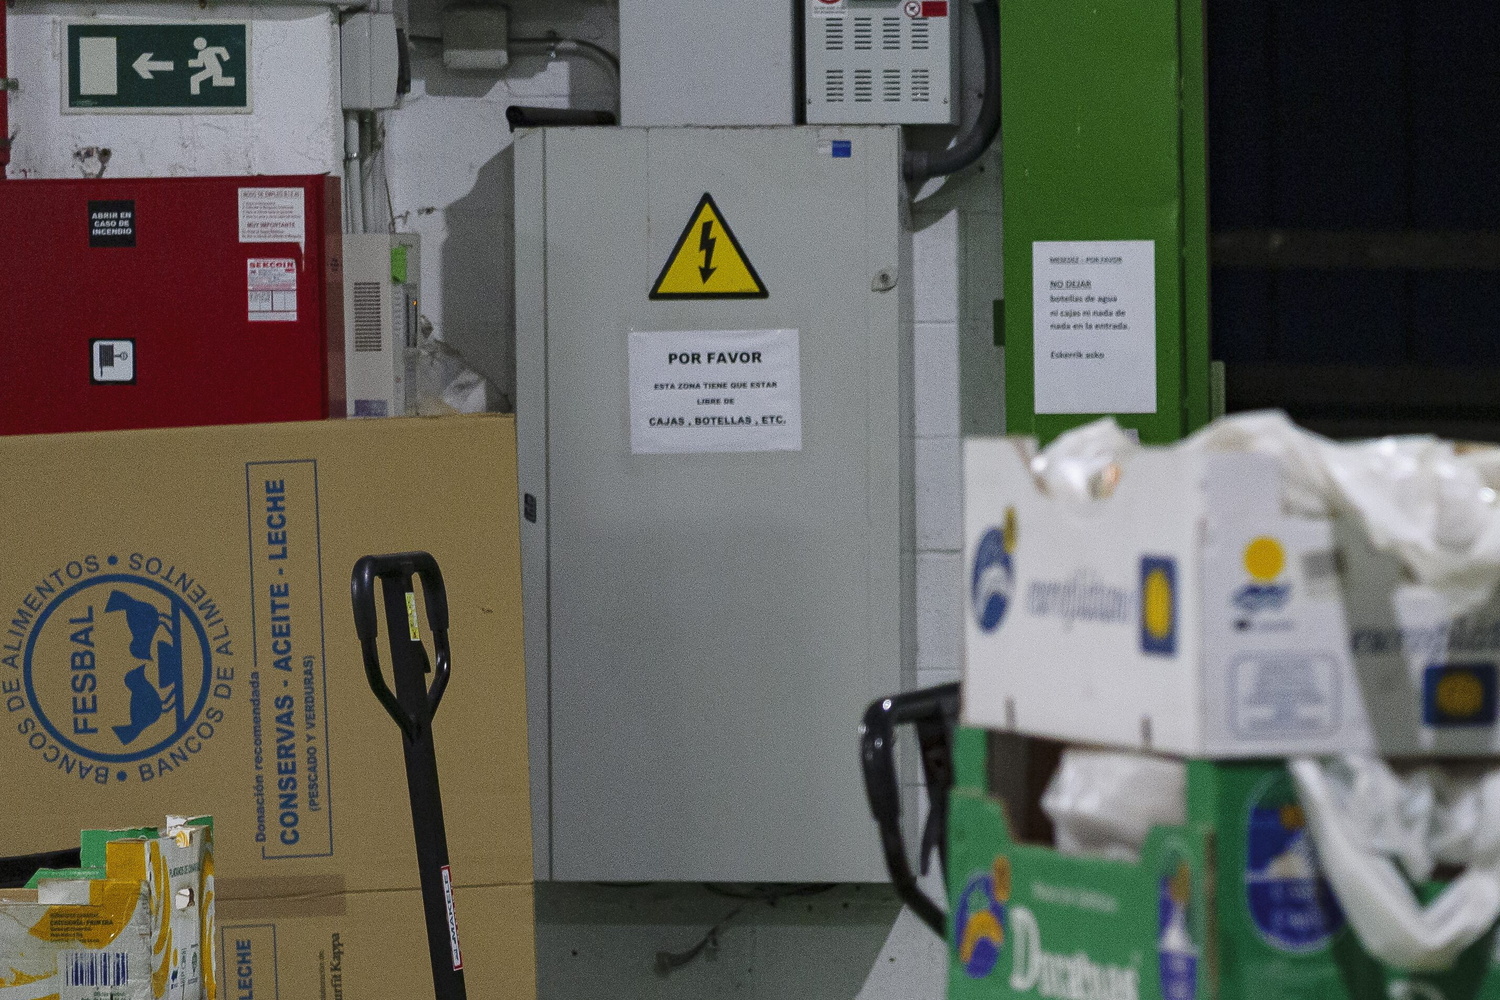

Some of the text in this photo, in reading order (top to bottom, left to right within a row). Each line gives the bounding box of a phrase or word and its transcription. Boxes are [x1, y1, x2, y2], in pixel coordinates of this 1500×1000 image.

[1098, 296, 1117, 304] agua
[668, 352, 762, 364] POR FAVOR
[649, 415, 787, 426] CAJAS BOTELLAS ETC.
[265, 478, 289, 560] LECHE
[128, 552, 235, 783] BANCOS DE ALIMENTOS
[269, 584, 293, 672] ACEITE
[2, 554, 109, 785] BANCOS DE ALIMENTOS
[70, 605, 99, 735] FESBAL
[304, 655, 316, 731] VERDURAS)
[253, 671, 267, 843] Donación recomendada
[275, 695, 301, 846] CONSERVAS
[308, 748, 320, 812] (PESCADO
[330, 932, 343, 972] Kappa
